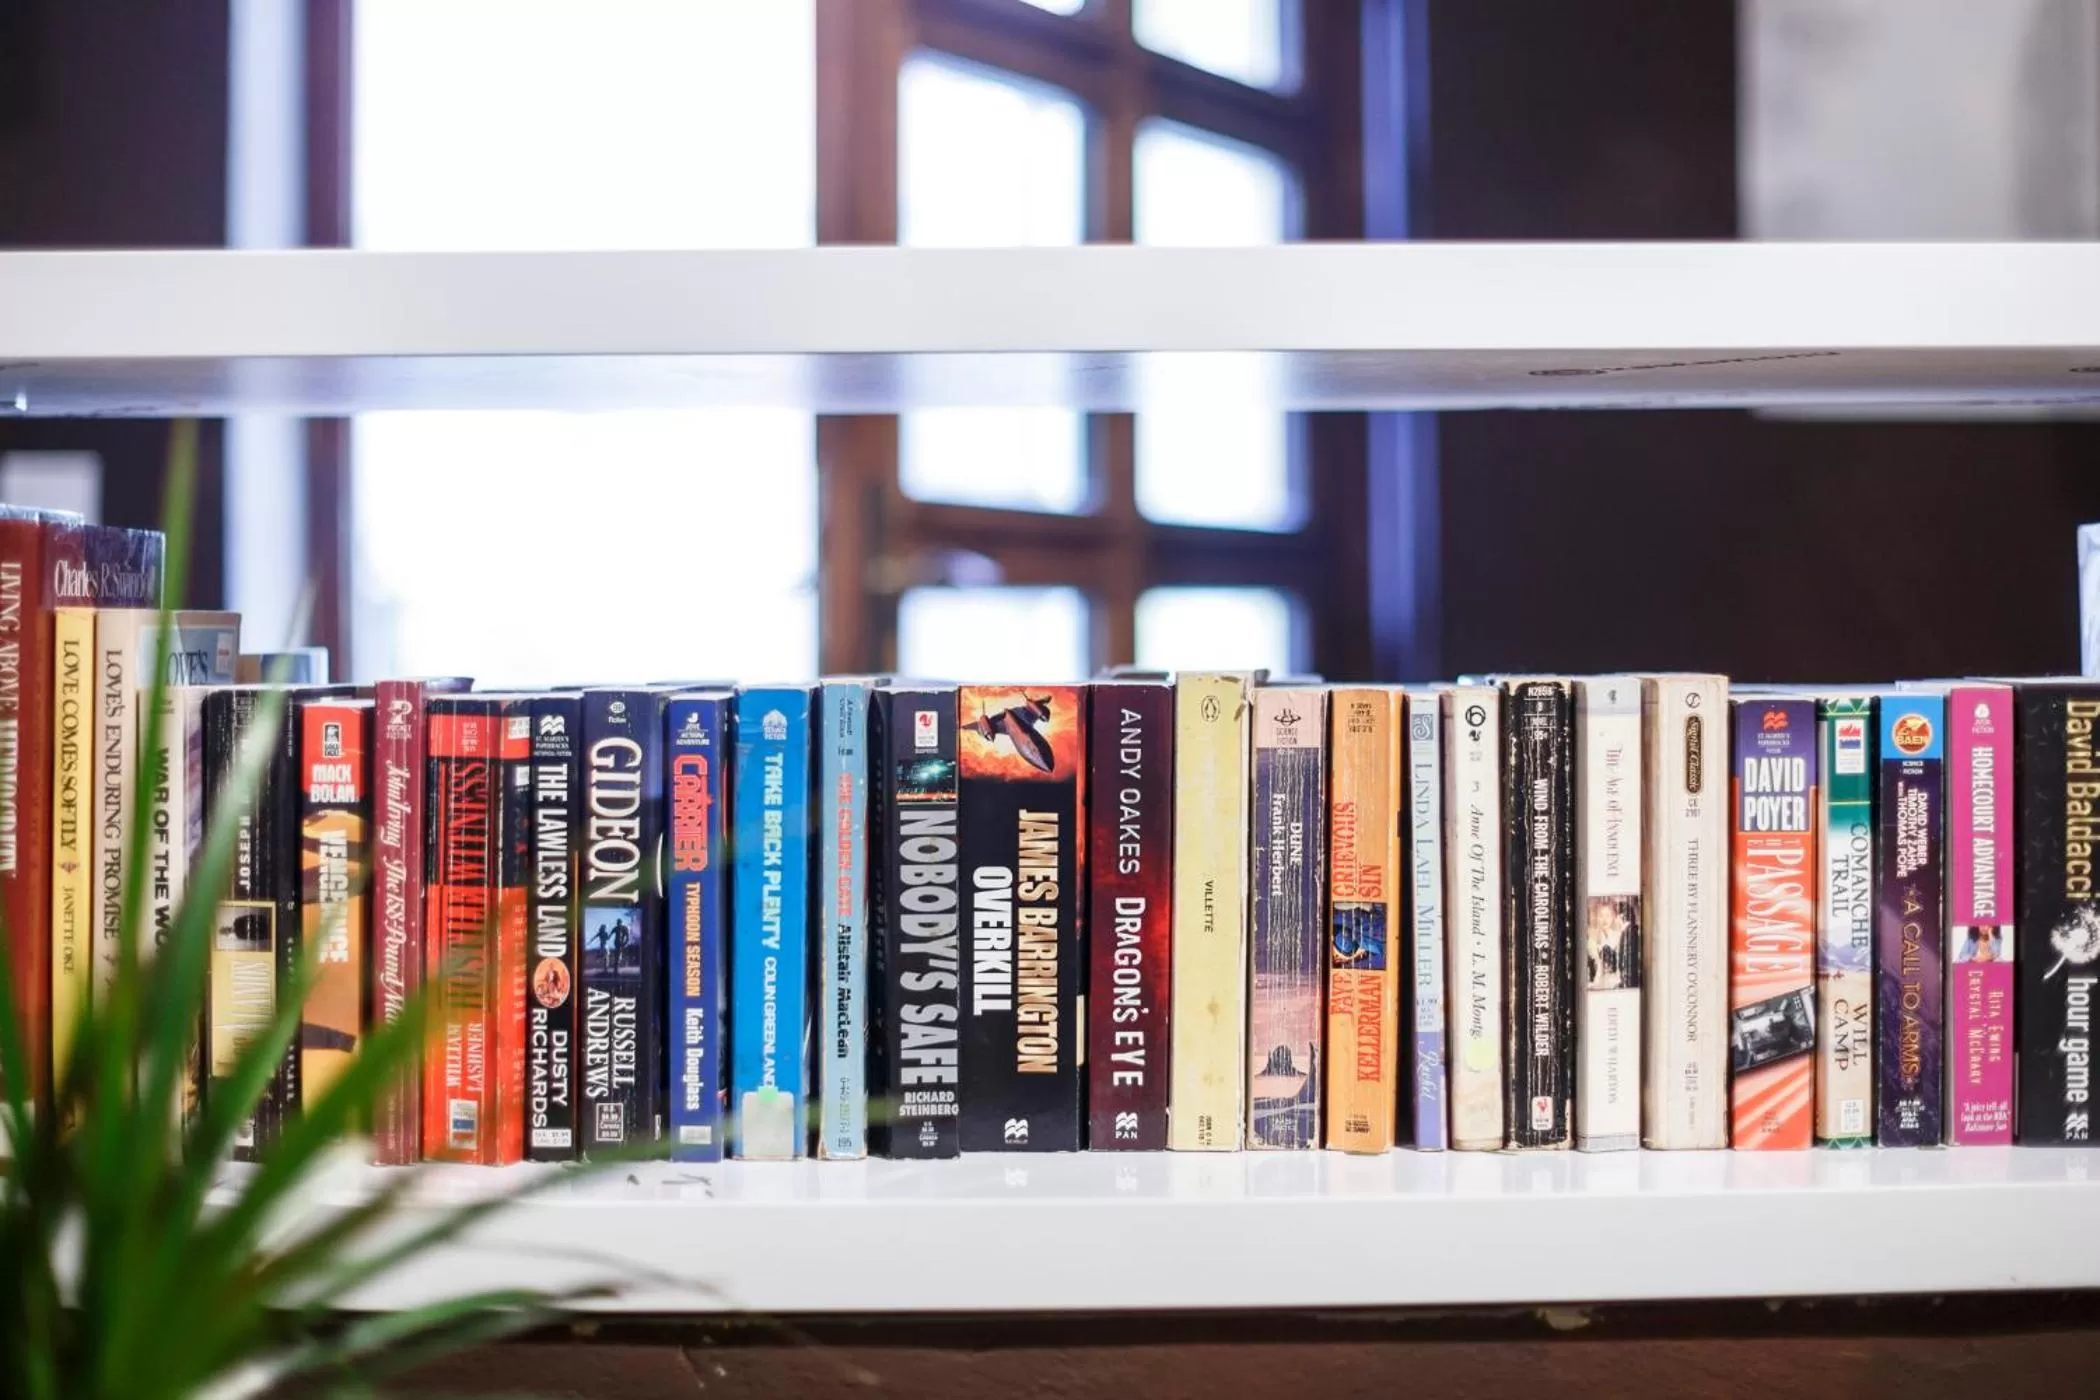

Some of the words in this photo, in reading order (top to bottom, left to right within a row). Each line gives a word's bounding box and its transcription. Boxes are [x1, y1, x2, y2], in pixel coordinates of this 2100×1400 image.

[1, 562, 21, 632] LIVING
[55, 559, 98, 598] Charles
[0, 637, 20, 713] ABOVE
[62, 640, 80, 697] LOVE
[105, 650, 126, 718] LOVE'S
[168, 649, 208, 686] OVE'S
[61, 700, 80, 774] COMES
[1120, 708, 1142, 778] ANDY
[1896, 735, 1928, 746] BAEN
[2066, 701, 2100, 775] David
[105, 724, 122, 838] ENDURING
[154, 747, 169, 803] WAR
[310, 783, 355, 803] BOLAN
[312, 764, 352, 783] MACK
[386, 760, 411, 800] John
[538, 764, 568, 802] THE
[764, 752, 784, 806] TAKE
[837, 773, 853, 803] THE
[1414, 763, 1434, 829] LINDA
[1533, 778, 1549, 811] WIND
[1688, 754, 1700, 790] Classic
[1744, 757, 1805, 792] DAVID
[1972, 746, 1995, 833] HOMECOURT
[59, 776, 77, 852] SOFTLY
[154, 809, 169, 844] OF
[382, 796, 411, 848] Irving
[449, 762, 488, 880] WITNESS
[588, 736, 643, 903] GIDEON
[673, 754, 709, 871] CARRIER
[1119, 788, 1141, 875] OAKES
[1271, 793, 1287, 834] Frank
[1469, 804, 1481, 839] Anne
[1533, 815, 1549, 850] FROM
[1744, 795, 1806, 830] POYER
[1896, 796, 1907, 845] THOMAS
[1907, 788, 1918, 835] TIMOTHY
[1916, 792, 1927, 827] DAVID
[239, 815, 251, 890] JOSEPH
[538, 808, 568, 897] LAWLESS
[763, 810, 783, 866] BACK
[837, 808, 853, 868] GOLDEN
[1018, 809, 1059, 902] JAMES
[1289, 822, 1303, 866] DUNE
[1333, 801, 1356, 896] GRIEVOUS
[1469, 843, 1484, 861] Of
[1533, 854, 1549, 878] THE
[1605, 818, 1622, 879] INNOCENCE
[1688, 839, 1699, 881] THREE
[1896, 847, 1907, 877] POPE
[1908, 838, 1919, 870] ZAHN
[1917, 830, 1927, 865] WEBER
[2065, 782, 2100, 900] Baldacci
[103, 847, 121, 940] PROMISE
[154, 853, 169, 899] THE
[383, 856, 407, 893] The
[1270, 840, 1286, 896] Herbert
[1359, 864, 1382, 899] SIN
[1415, 839, 1434, 896] LAEL
[1471, 867, 1485, 890] The
[1688, 883, 1698, 898] BY
[1831, 855, 1849, 917] TRAIL
[1850, 823, 1869, 949] COMANCHE
[1972, 837, 1995, 917] ADVANTAGE
[62, 887, 76, 943] JANETTE
[319, 830, 349, 963] VENGEANCE
[684, 882, 701, 941] TYPHOON
[761, 870, 782, 949] PLENTY
[837, 876, 853, 917] GATE
[900, 810, 958, 990] NOBODY'S
[1204, 880, 1214, 933] VILLETTE
[1471, 895, 1485, 936] Island
[1534, 882, 1550, 949] CAROLINAS
[1746, 849, 1805, 974] PASSAGE
[1904, 899, 1919, 914] A
[448, 891, 487, 1010] HOSTILE
[537, 905, 568, 957] LAND
[837, 923, 851, 983] Alistair
[973, 866, 1013, 1015] OVERKILL
[1417, 904, 1436, 986] MILLER
[1472, 952, 1486, 966] L.
[1687, 903, 1698, 971] FLANNERY
[1903, 922, 1921, 975] CALL
[62, 946, 76, 974] OKE
[685, 945, 701, 997] SEASON
[763, 957, 777, 999] COLIN
[1112, 897, 1149, 1023] DRAGON'S
[1472, 972, 1486, 991] M.
[1534, 965, 1551, 1009] ROBERT
[1018, 907, 1059, 1073] BARRINGTON
[1330, 972, 1354, 1015] FAYE
[1687, 972, 1698, 1042] O'CONNOR
[1904, 982, 1920, 1010] TO
[1968, 970, 1984, 1020] CRYSTAL
[1988, 991, 2005, 1018] RITA
[2067, 977, 2098, 1031] hour
[587, 987, 609, 1098] ANDREWS
[613, 996, 636, 1089] RUSSELL
[685, 1008, 704, 1044] Keith
[763, 1002, 777, 1087] GREENLAND
[837, 987, 851, 1058] MacLean
[901, 1004, 959, 1084] SAFE
[1357, 974, 1382, 1082] KELLERMAN
[1534, 1012, 1551, 1057] WILDER
[1607, 1007, 1618, 1041] EDITH
[1833, 999, 1850, 1071] CAMP
[1852, 1003, 1869, 1067] WILL
[1901, 1014, 1921, 1076] ARMS
[1988, 1026, 2005, 1062] EWING
[447, 1022, 462, 1088] WILLIAM
[467, 1023, 482, 1091] LASHNER
[532, 1008, 548, 1127] RICHARDS
[552, 1030, 567, 1106] DUSTY
[682, 1047, 704, 1110] Douglass
[1111, 1030, 1147, 1086] EYE
[1418, 1041, 1439, 1099] Rachel
[1607, 1045, 1618, 1104] WHARTON
[2058, 1037, 2090, 1103] game
[899, 1103, 960, 1117] STEINBERG
[904, 1091, 955, 1103] RICHARD
[1115, 1130, 1139, 1139] PAN
